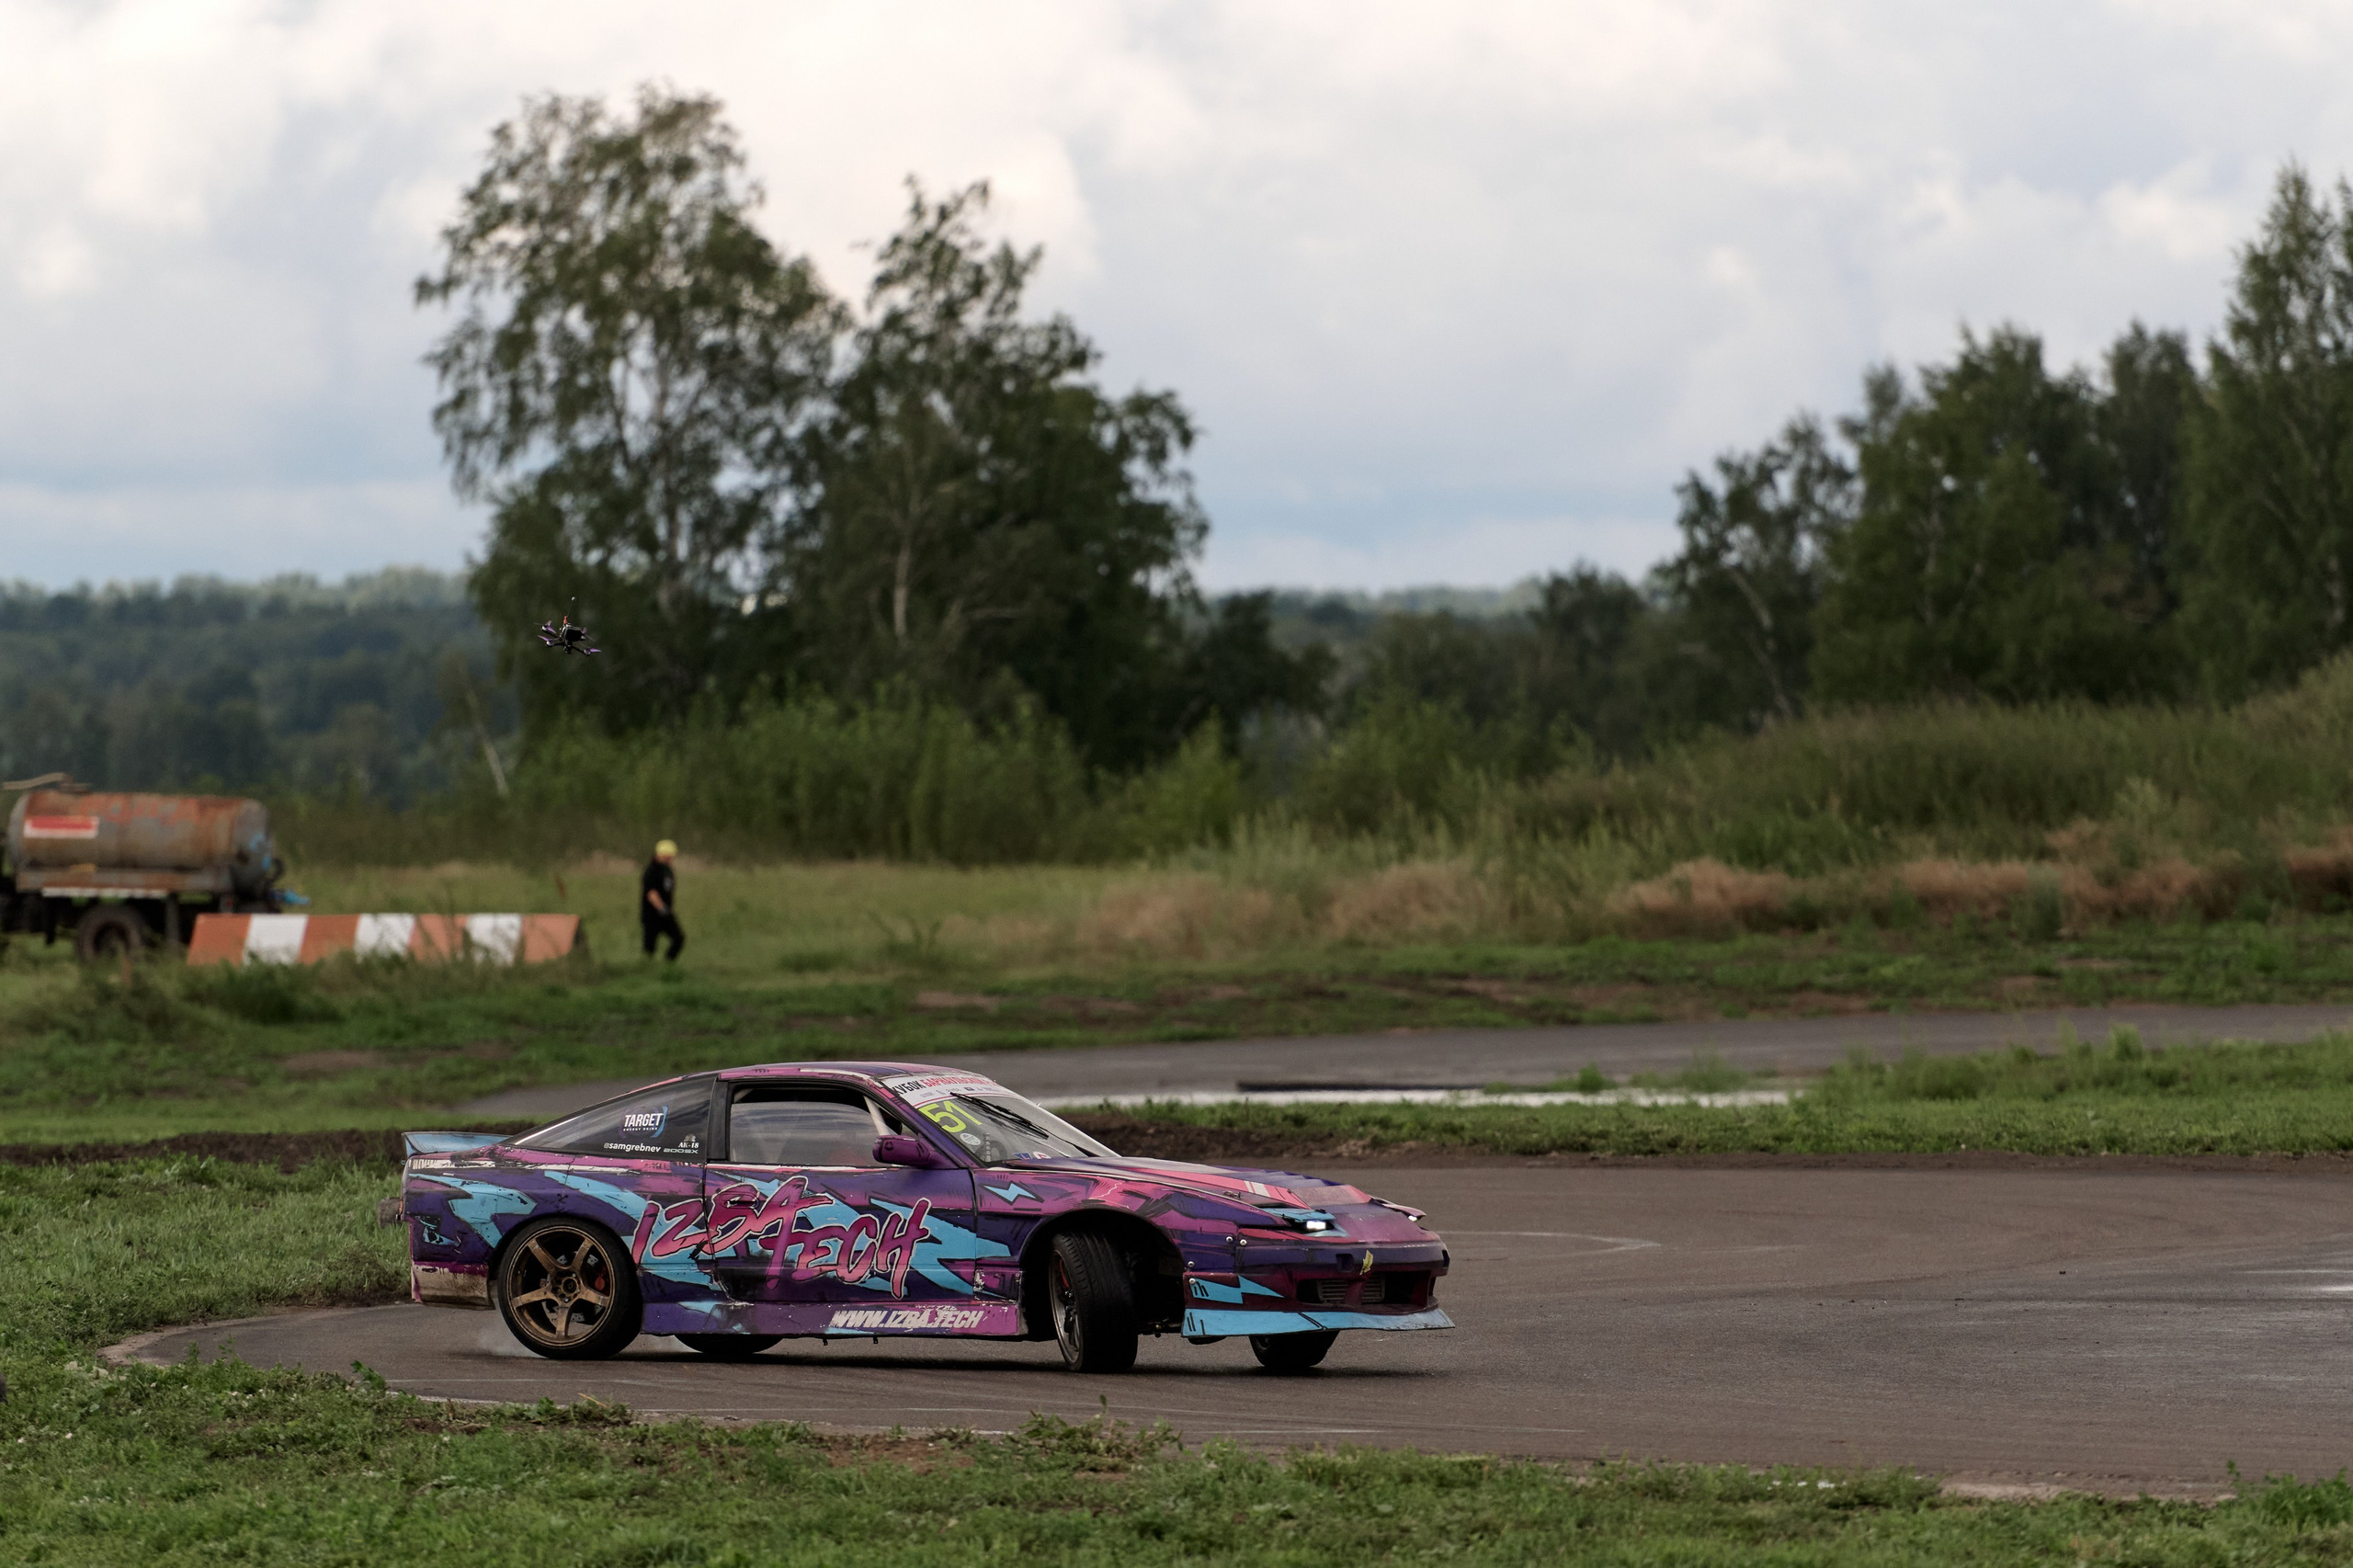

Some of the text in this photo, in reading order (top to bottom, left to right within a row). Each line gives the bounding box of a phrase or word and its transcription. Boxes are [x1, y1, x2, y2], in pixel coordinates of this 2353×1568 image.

[624, 1112, 664, 1127] TARGET
[919, 1100, 983, 1132] 51
[604, 1142, 662, 1153] @samgrebnev
[631, 1176, 932, 1300] IZBA TECH
[829, 1310, 984, 1329] WWW.IZBA.TECH
